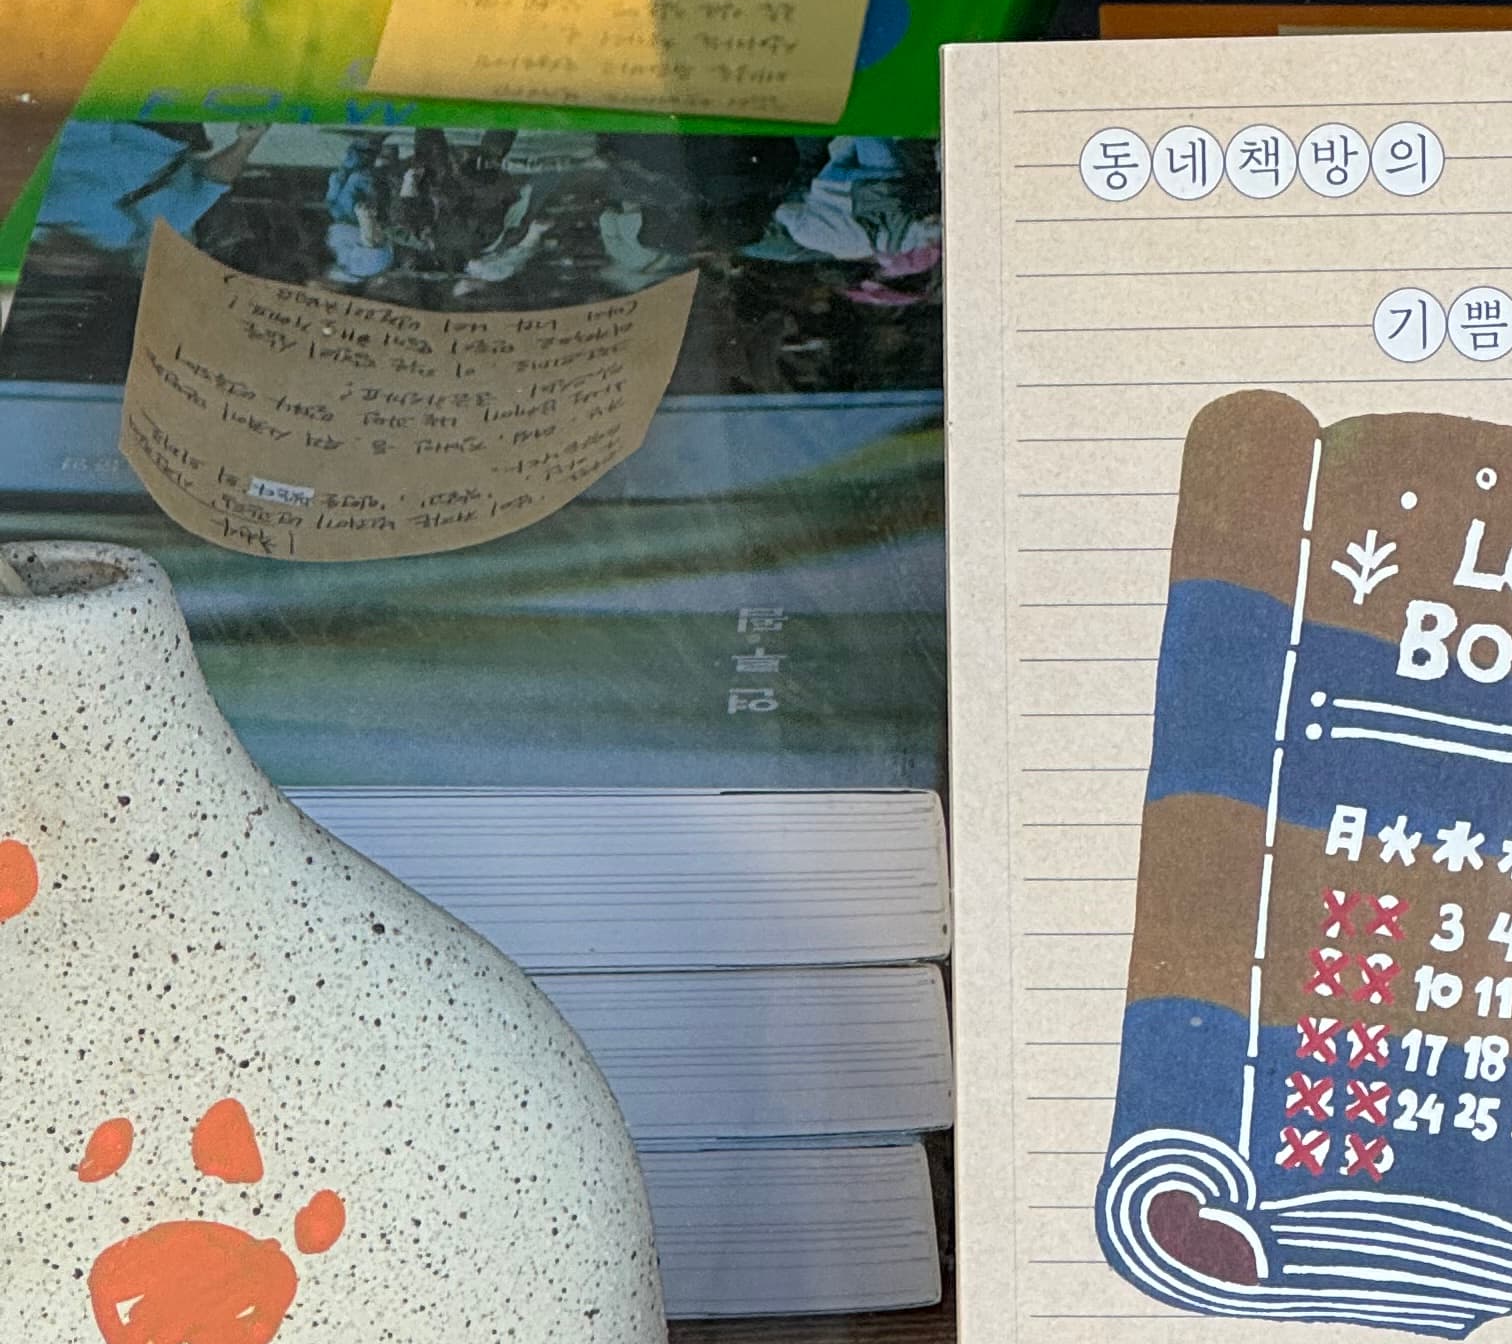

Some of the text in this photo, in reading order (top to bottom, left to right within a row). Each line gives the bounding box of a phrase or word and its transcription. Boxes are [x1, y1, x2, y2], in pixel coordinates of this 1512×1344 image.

[1085, 126, 1437, 196] 동네책방의
[1430, 903, 1465, 951] 3
[1414, 965, 1463, 1011] 10
[1401, 1029, 1448, 1076] 17
[1464, 1035, 1509, 1082] 18
[1393, 1088, 1444, 1135] 24
[1454, 1092, 1500, 1142] 25
